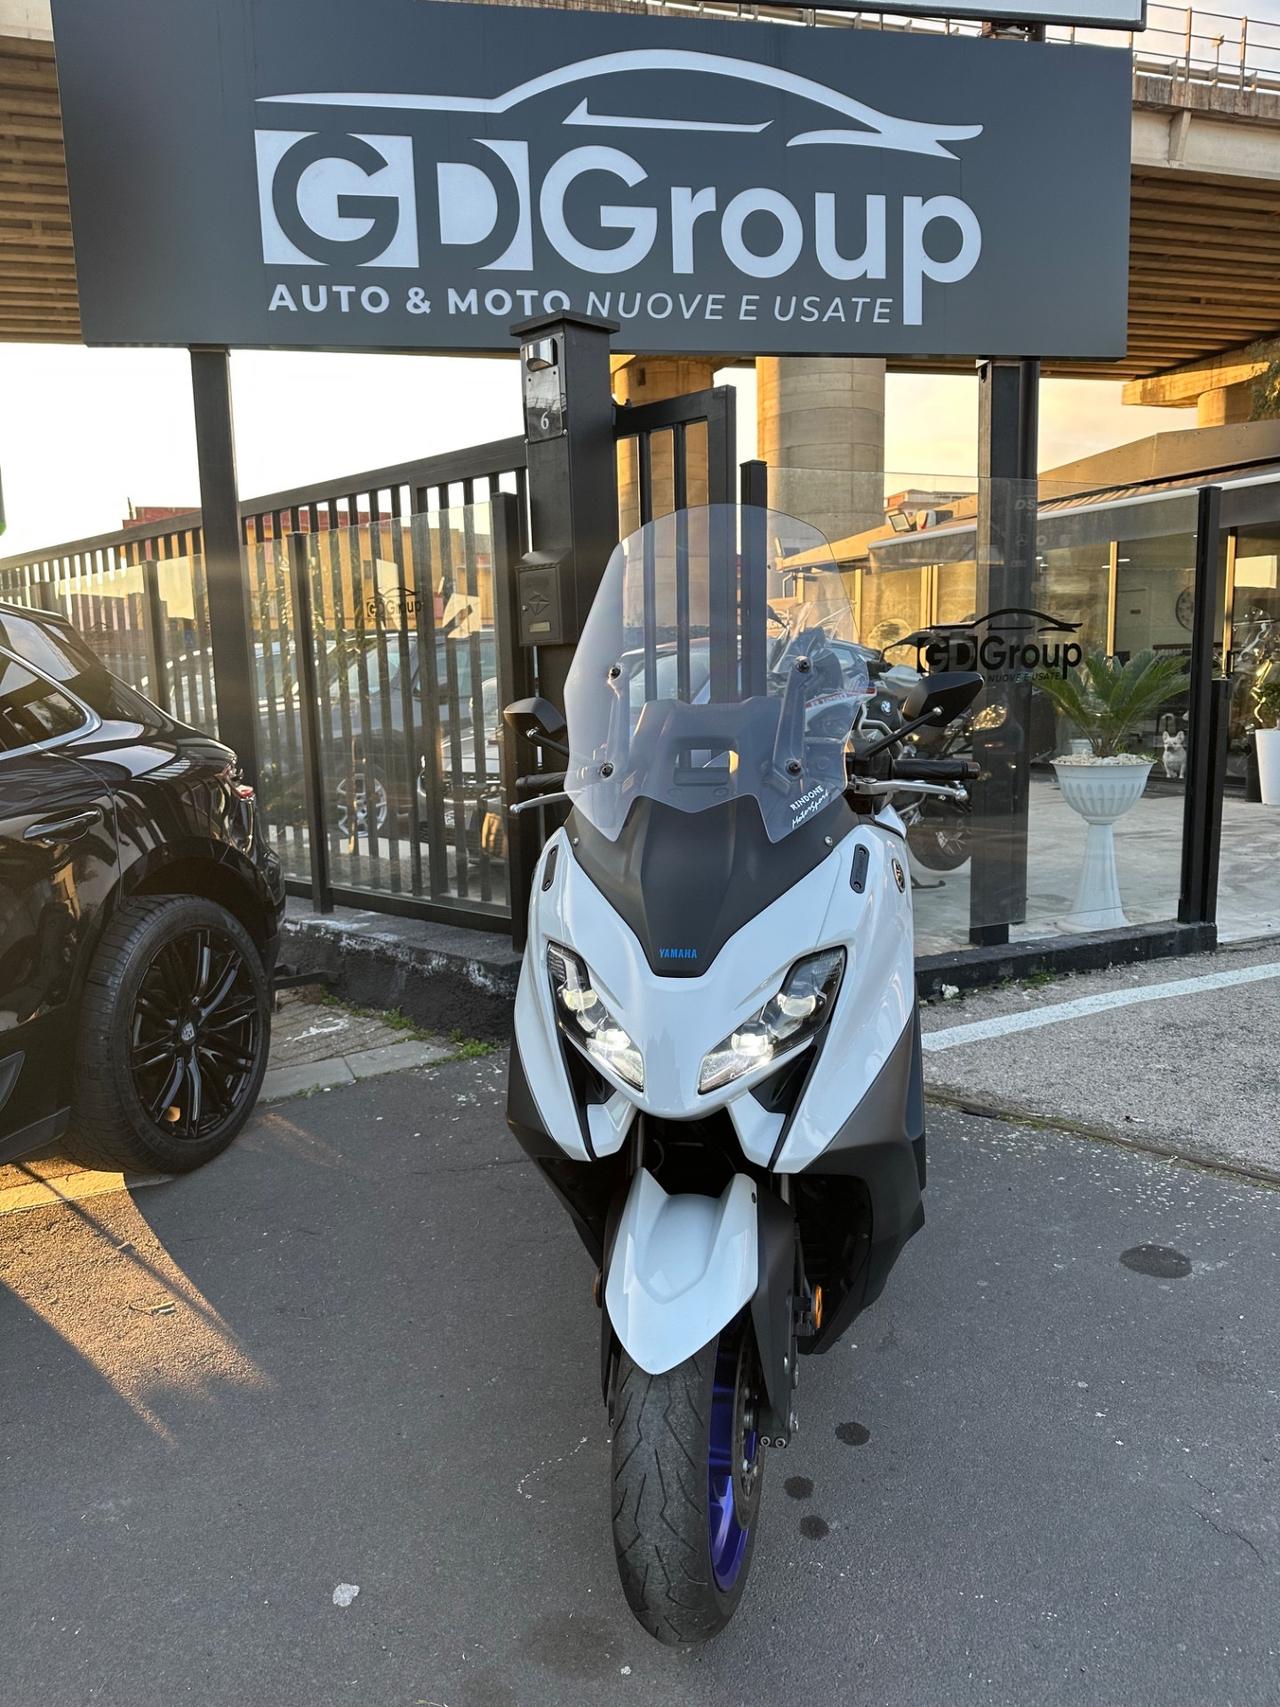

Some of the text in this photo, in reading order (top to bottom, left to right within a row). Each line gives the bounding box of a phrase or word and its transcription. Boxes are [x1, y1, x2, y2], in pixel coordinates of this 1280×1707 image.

[254, 129, 983, 326] GDGroup
[268, 284, 894, 324] AUTO & MOTO NUOVE E USATE
[540, 411, 549, 430] 6
[917, 635, 1083, 680] GDGroup
[790, 785, 824, 811] RINDONE
[659, 948, 698, 959] YAMAHA
